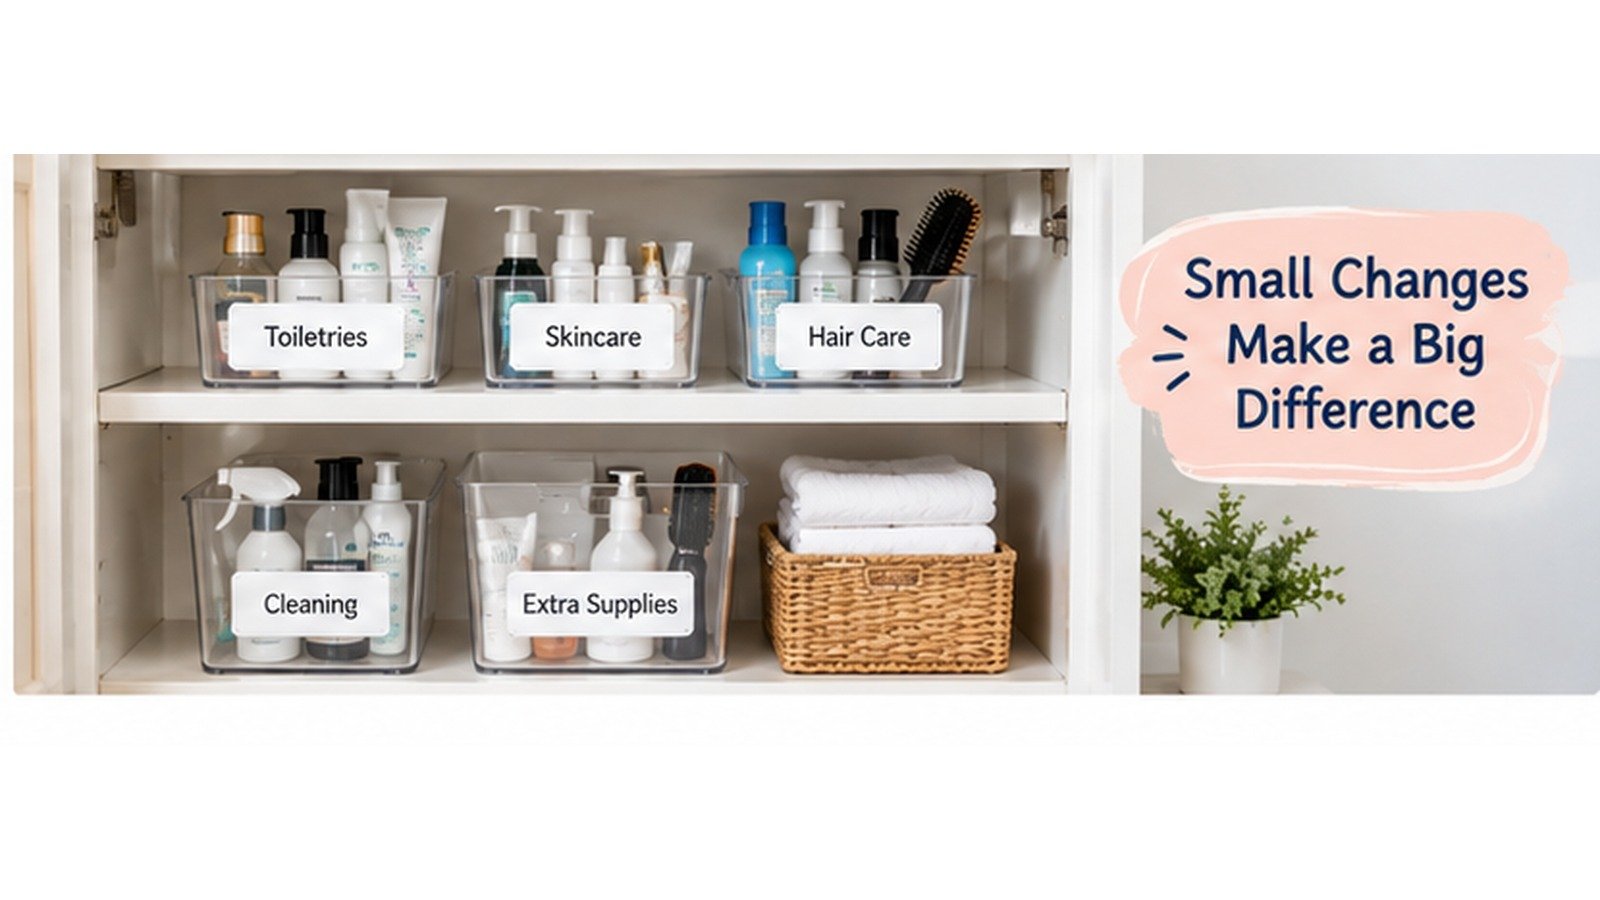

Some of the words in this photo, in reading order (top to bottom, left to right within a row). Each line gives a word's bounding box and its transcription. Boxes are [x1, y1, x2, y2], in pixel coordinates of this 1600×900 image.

[264, 325, 368, 348] Toiletries
[545, 325, 642, 348] Skincare
[809, 325, 855, 348] Hair
[860, 325, 911, 348] Care
[264, 593, 358, 620] Cleaning
[523, 592, 580, 616] Extra
[586, 592, 679, 620] Supplies
